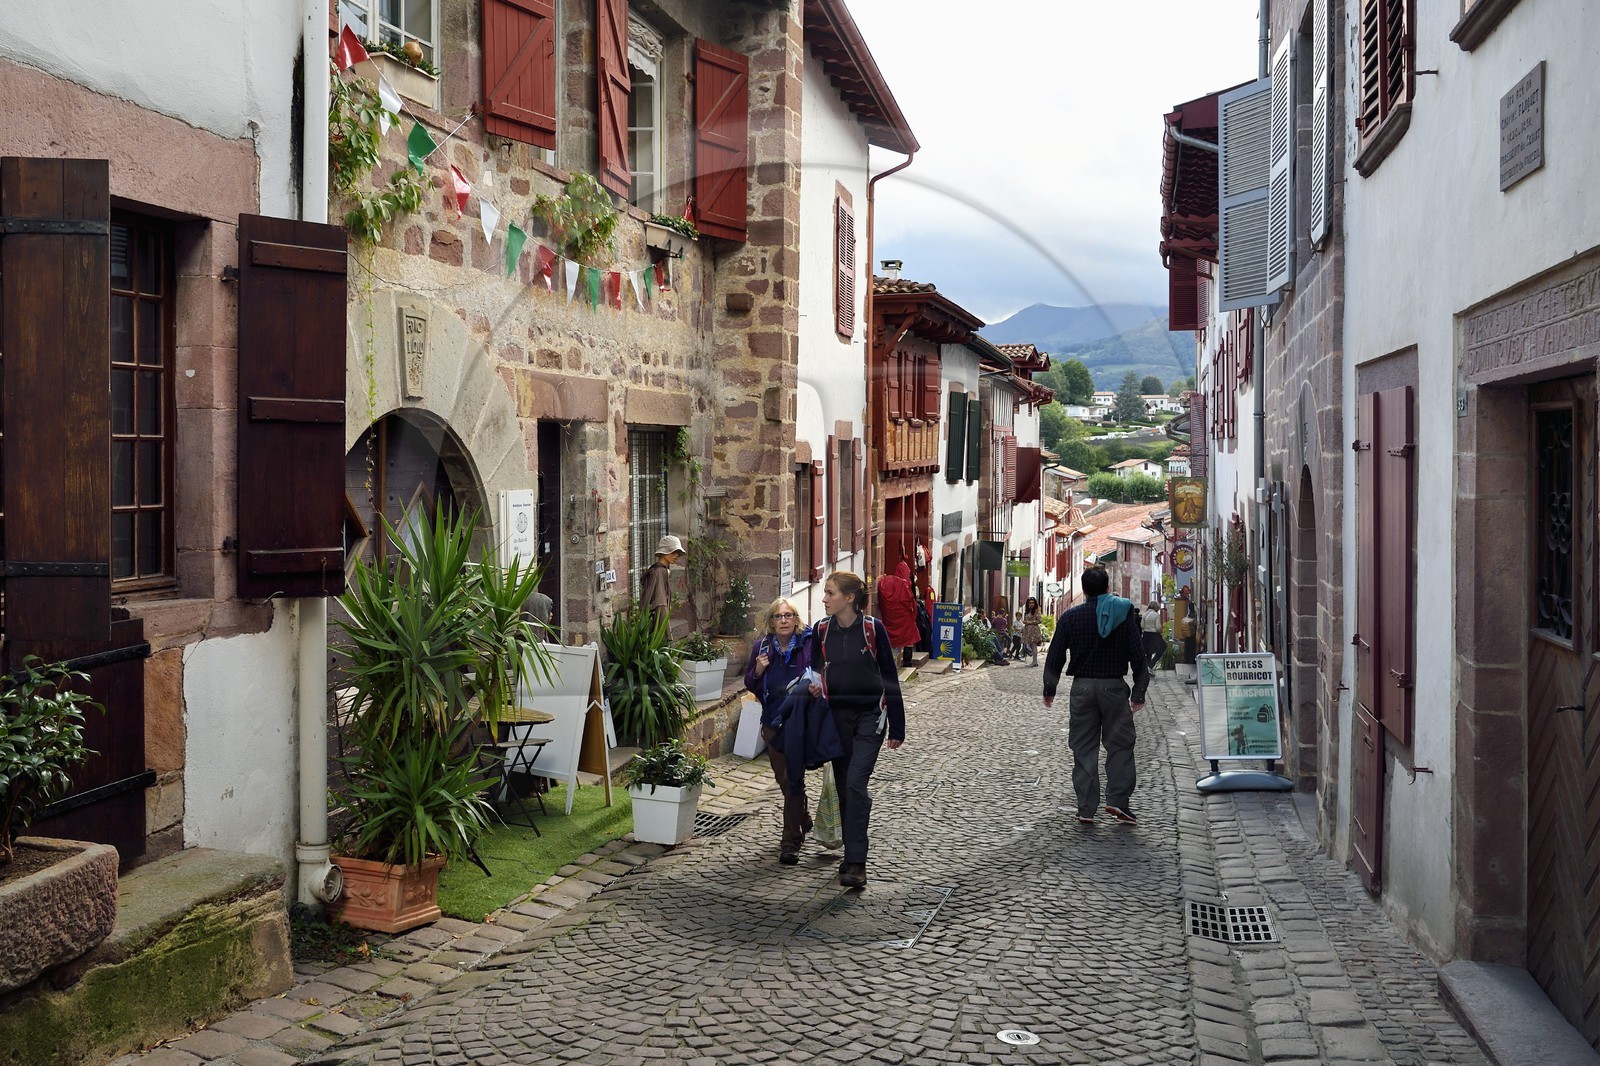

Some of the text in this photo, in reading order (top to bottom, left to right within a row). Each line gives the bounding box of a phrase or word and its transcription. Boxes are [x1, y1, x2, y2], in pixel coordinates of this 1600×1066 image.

[1226, 660, 1263, 669] EXPRESS
[1227, 671, 1273, 681] BOURRICOT
[1228, 688, 1275, 697] TRANSPORT
